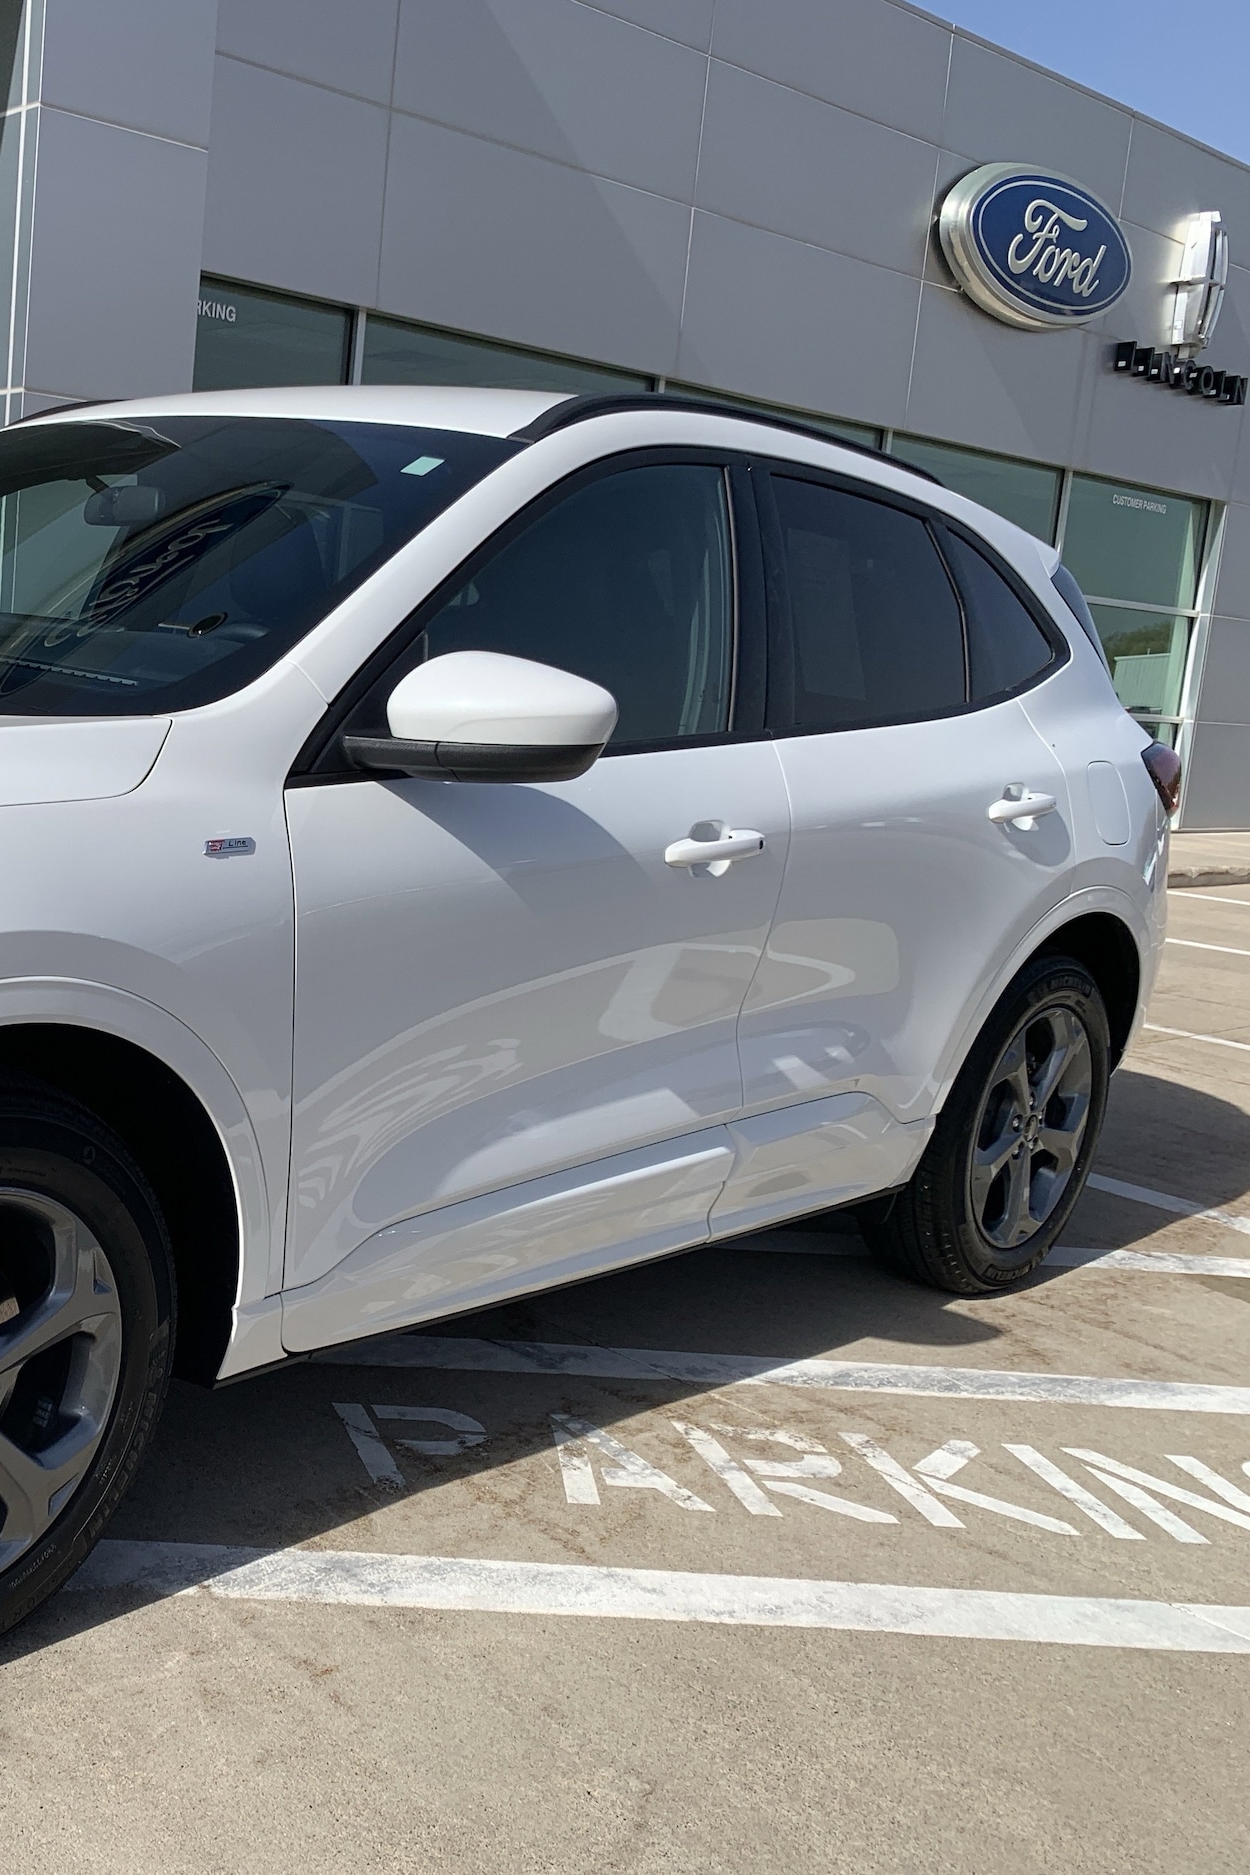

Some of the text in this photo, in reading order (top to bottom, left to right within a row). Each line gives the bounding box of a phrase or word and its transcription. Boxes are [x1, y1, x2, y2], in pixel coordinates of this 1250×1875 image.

[1008, 199, 1107, 298] Ford
[1112, 494, 1143, 509] CUSTOMER
[332, 1401, 1250, 1545] PARKIN
